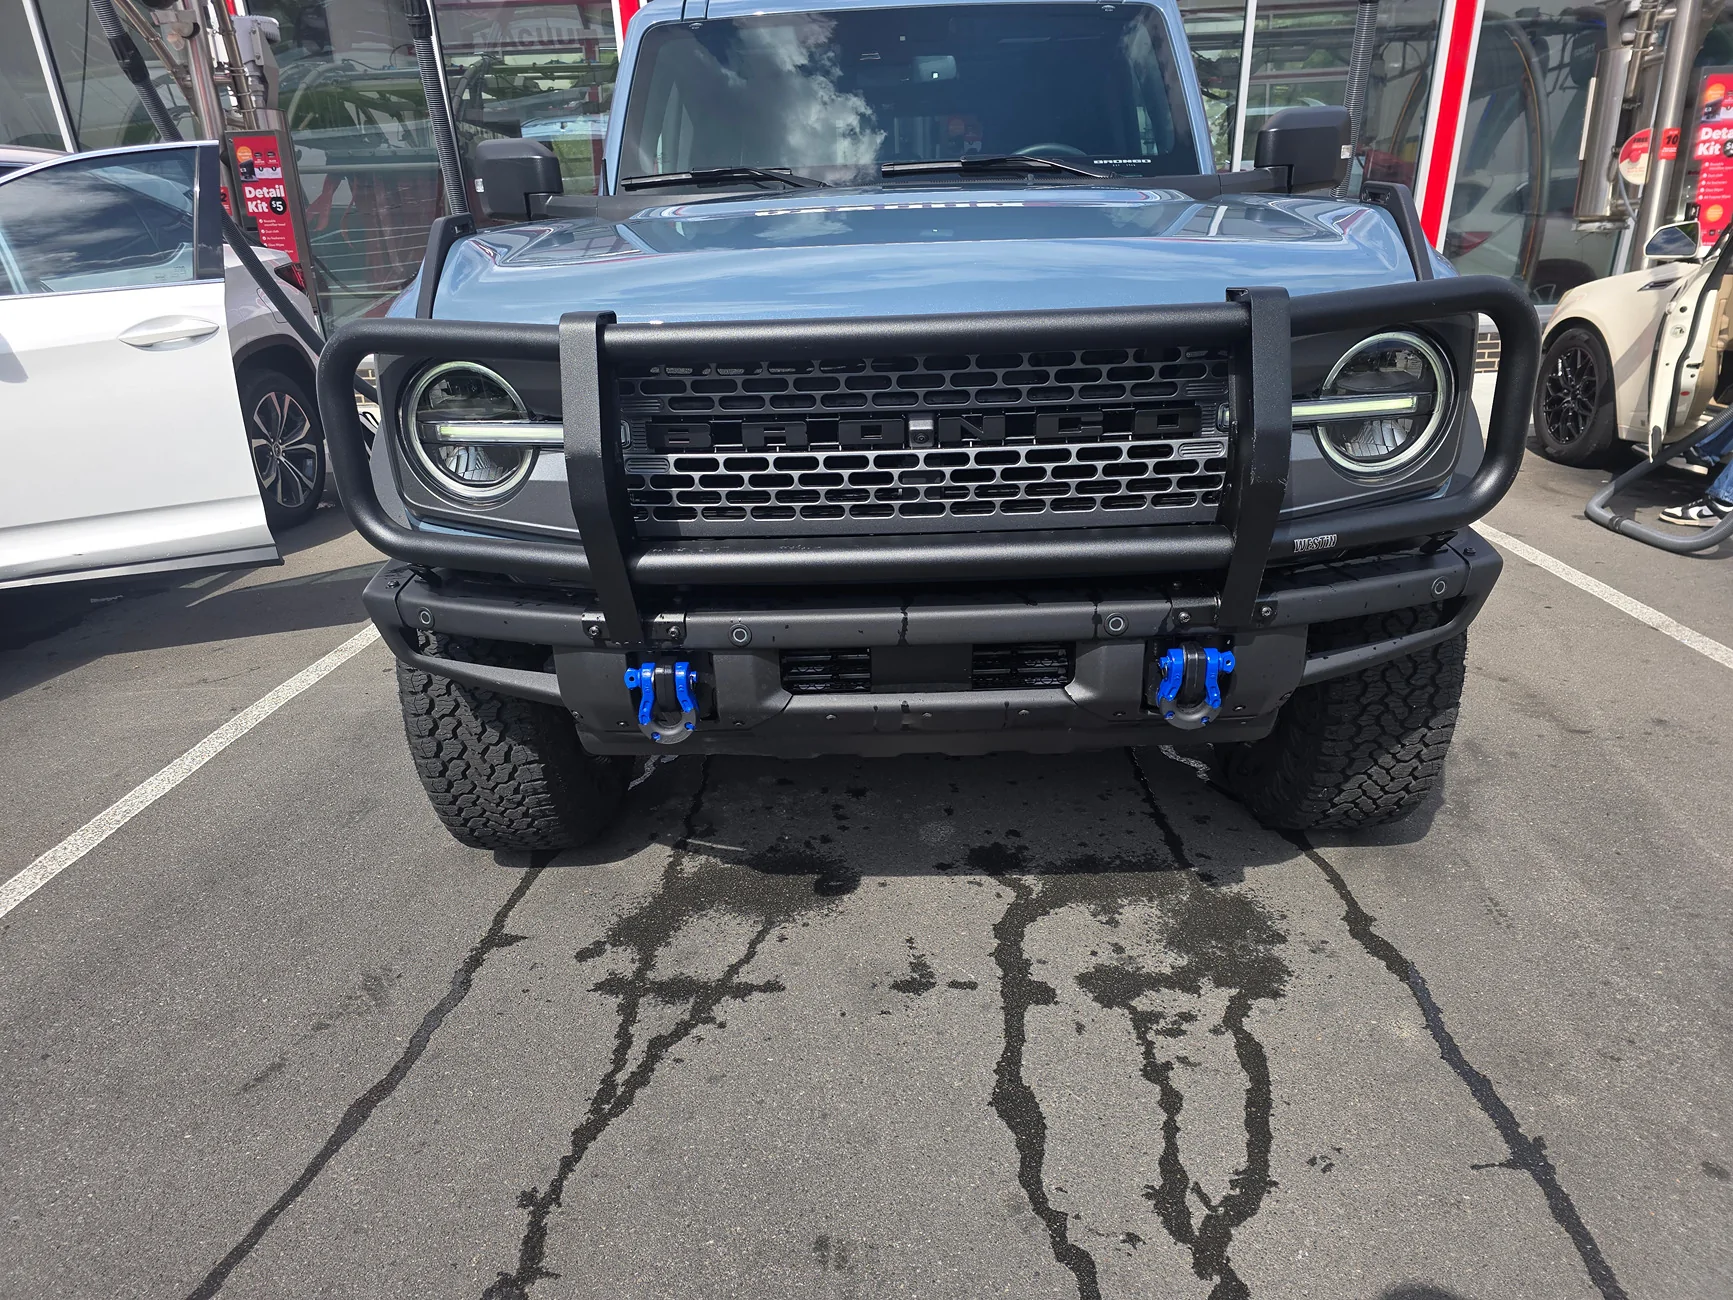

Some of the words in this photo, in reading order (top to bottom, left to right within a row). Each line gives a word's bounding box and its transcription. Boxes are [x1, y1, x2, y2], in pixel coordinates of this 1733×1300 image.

[1666, 134, 1679, 145] 10
[1698, 142, 1721, 156] Kit
[244, 185, 285, 198] Detail
[247, 200, 269, 212] Kit
[271, 201, 284, 211] $5
[648, 407, 1200, 449] BRONCO
